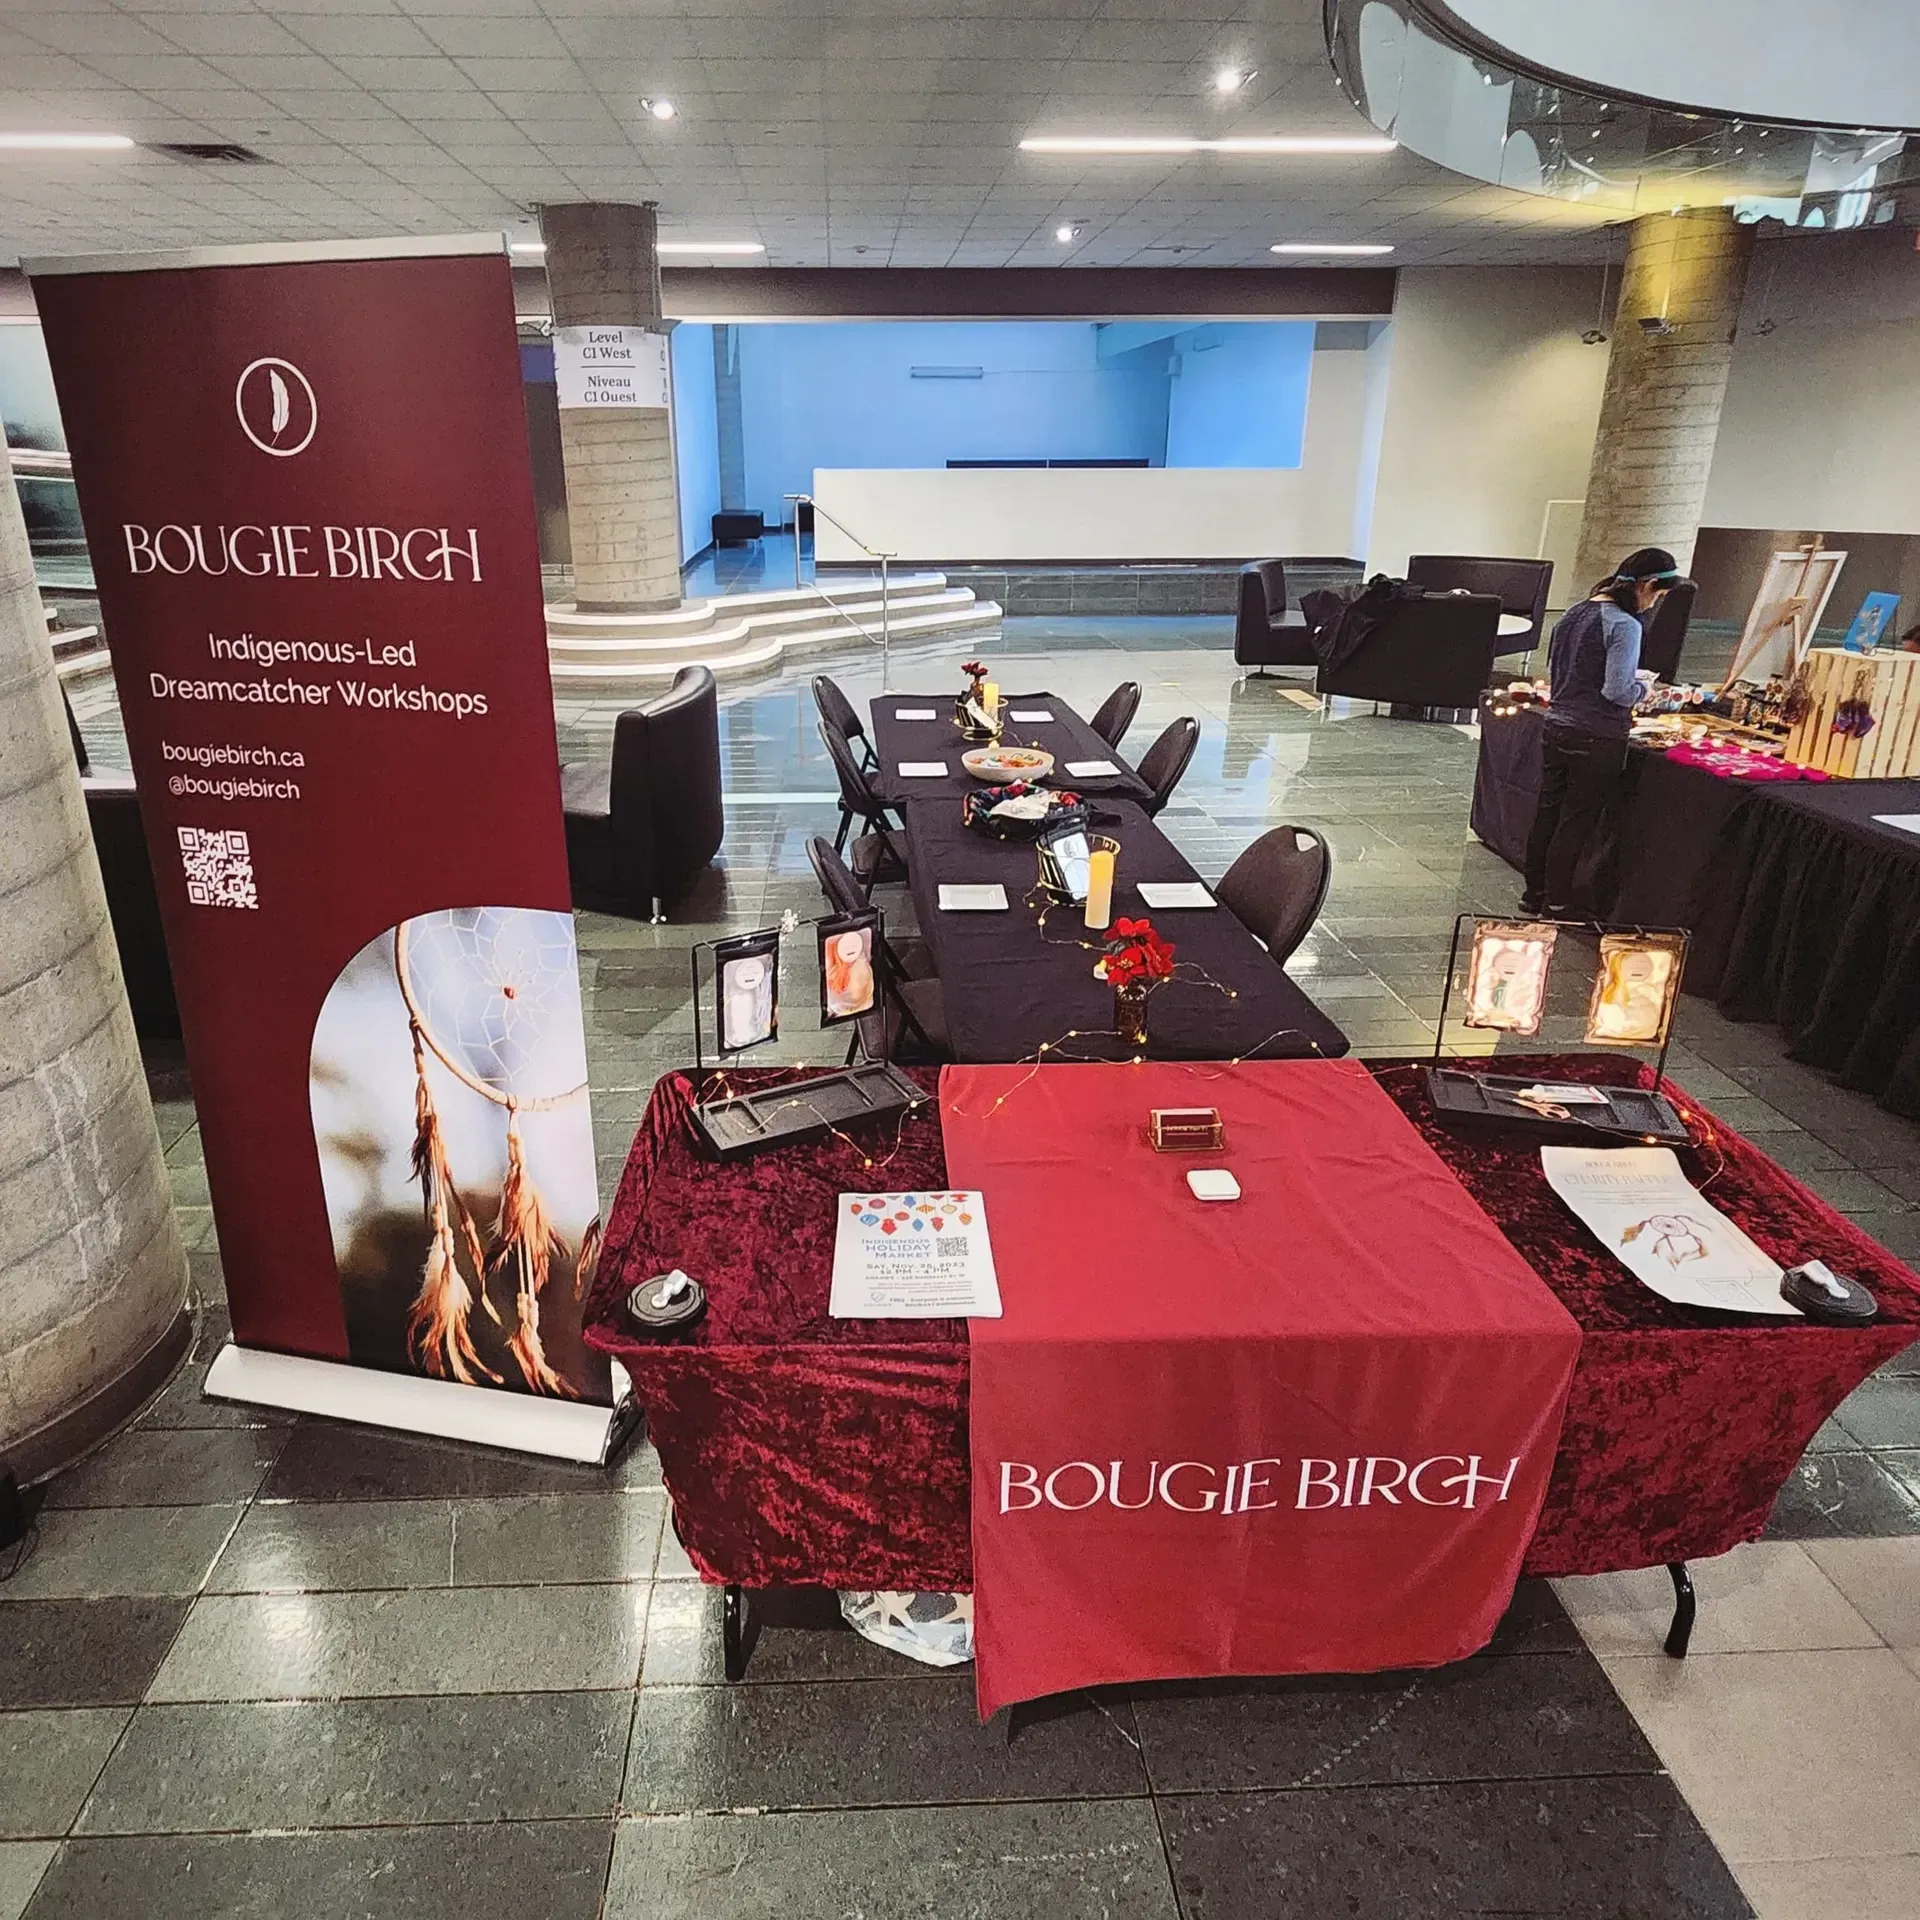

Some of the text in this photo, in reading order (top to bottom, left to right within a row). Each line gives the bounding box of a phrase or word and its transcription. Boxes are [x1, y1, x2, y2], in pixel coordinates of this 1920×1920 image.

[588, 331, 623, 344] Level
[599, 347, 632, 359] West
[587, 375, 631, 387] Niveau
[600, 391, 637, 403] Ouest
[123, 524, 483, 582] BOUGIE BIRCH
[208, 632, 417, 668] Indigenous-Led
[149, 672, 489, 720] Dreamcatcher Workshops
[162, 740, 306, 768] bougiebirch.ca
[168, 774, 301, 801] @bougiebirch
[865, 1244, 931, 1252] HOLIDAY
[999, 1455, 1520, 1515] BOUGIE BIRCH
